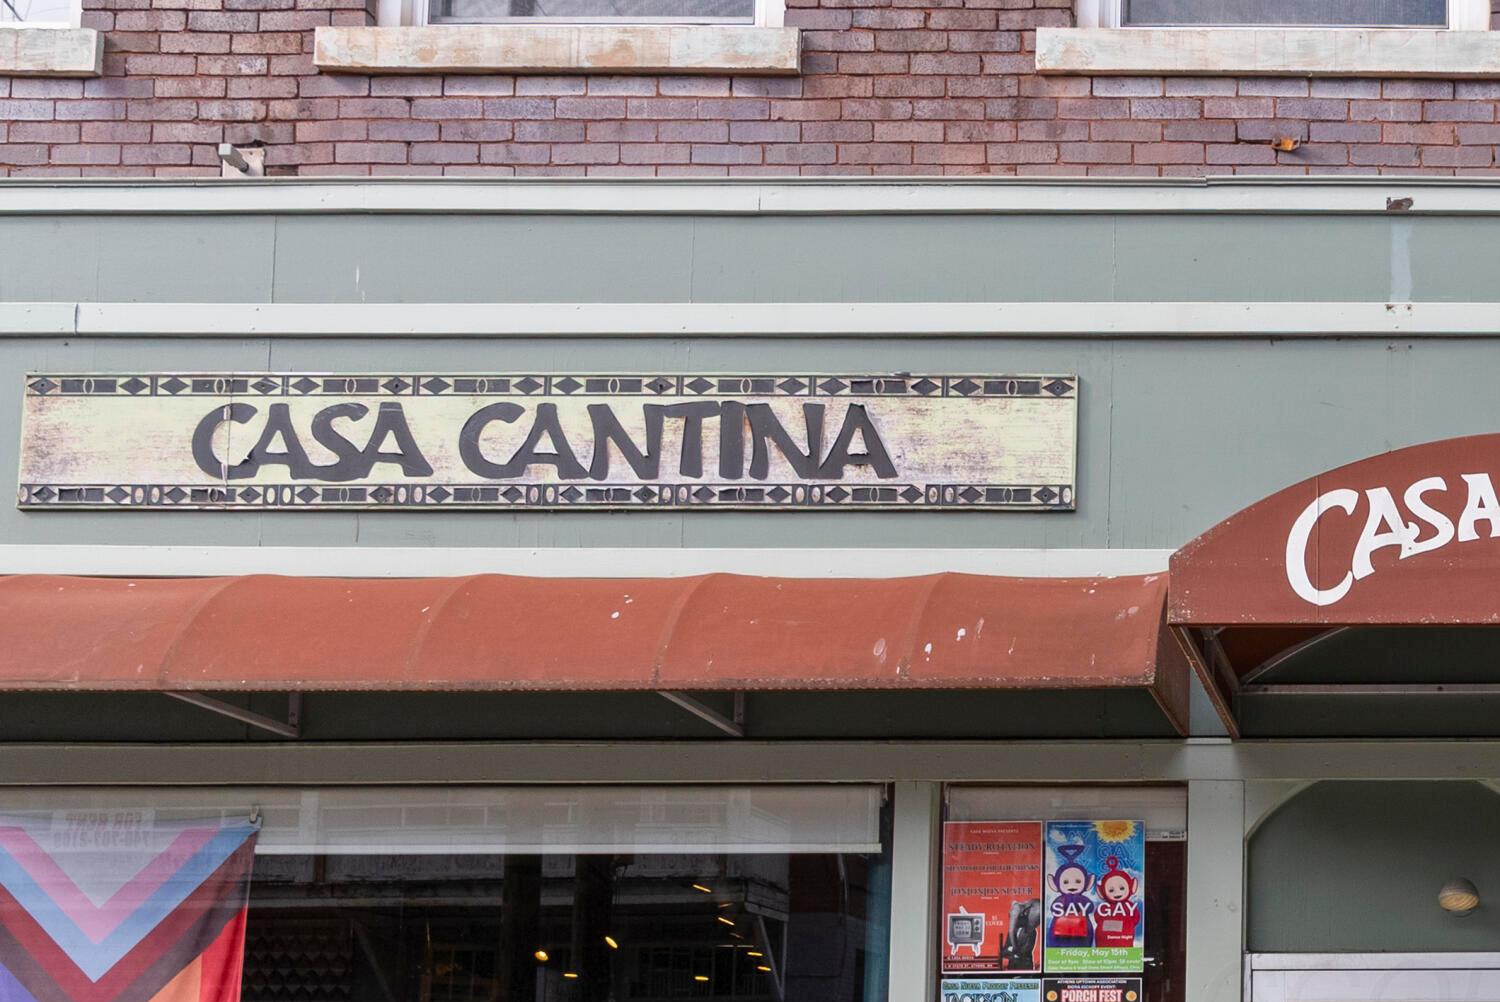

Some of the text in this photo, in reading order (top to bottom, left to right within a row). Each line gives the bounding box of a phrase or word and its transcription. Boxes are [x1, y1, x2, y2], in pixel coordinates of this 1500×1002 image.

[190, 401, 900, 481] CASA CANTINA
[1052, 902, 1138, 917] SAY GAY
[1060, 949, 1090, 957] Friday,
[1091, 949, 1109, 957] May
[1061, 990, 1123, 1002] PORCH FEST
